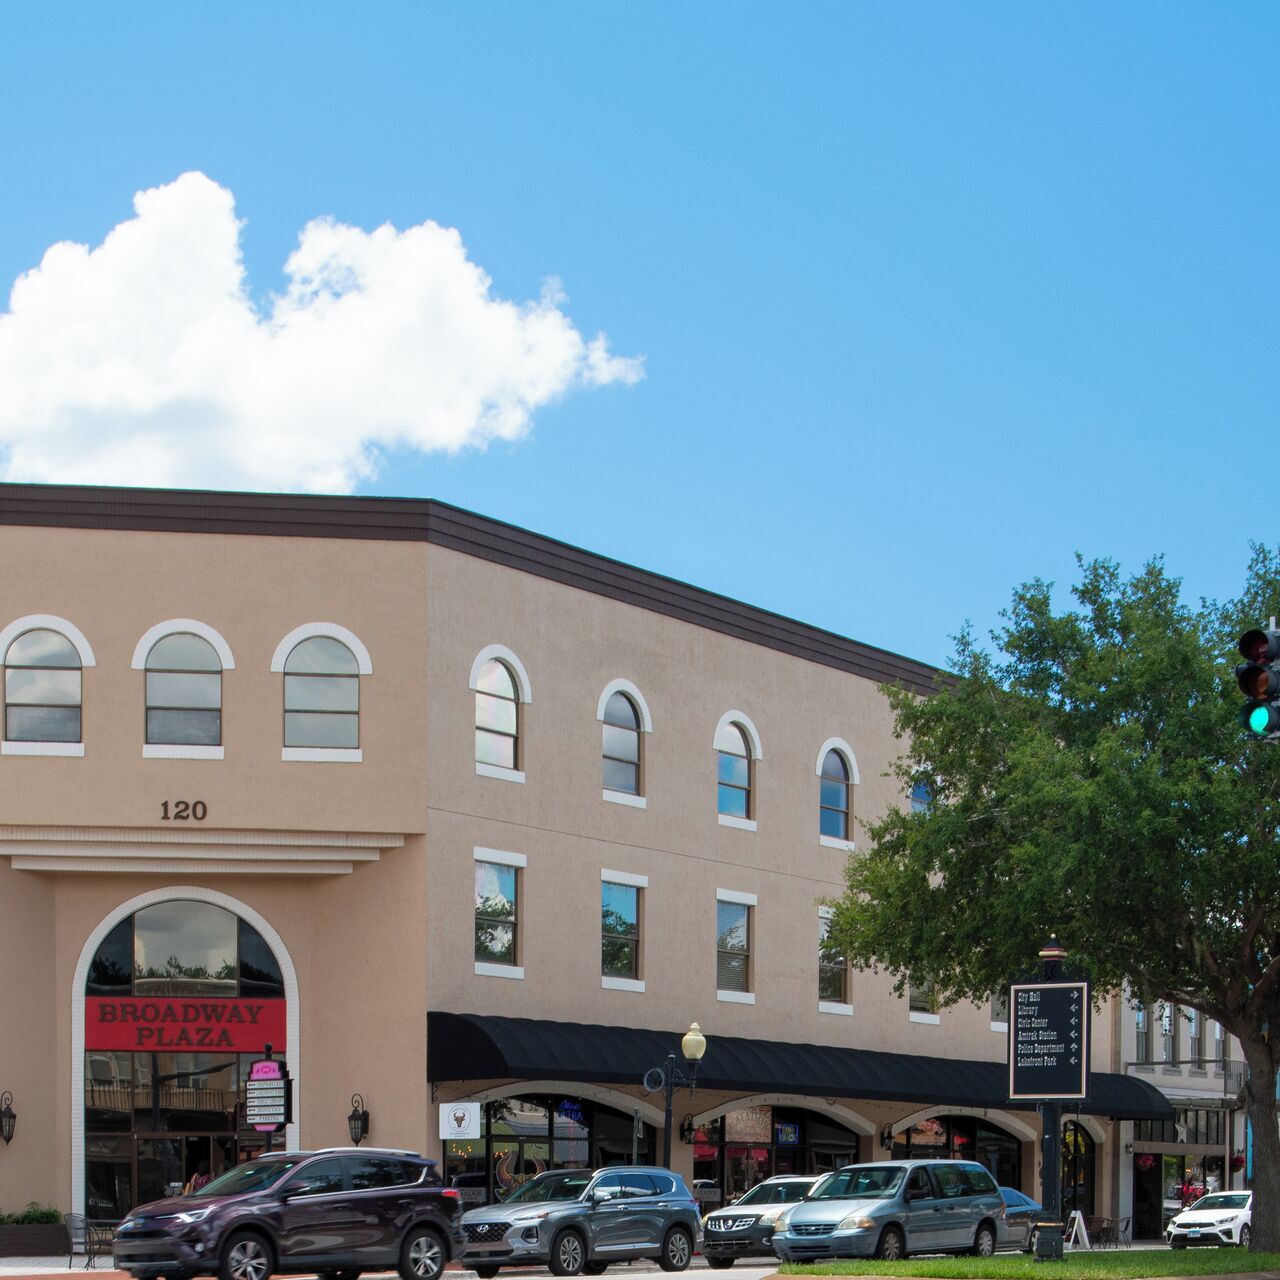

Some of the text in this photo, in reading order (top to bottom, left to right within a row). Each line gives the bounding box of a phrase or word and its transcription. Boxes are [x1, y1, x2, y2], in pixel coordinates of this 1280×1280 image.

[161, 800, 207, 820] 120
[1018, 991, 1040, 1004] City Hall
[98, 1003, 264, 1024] BROADWAY
[1018, 1005, 1038, 1016] Library
[1031, 1018, 1048, 1028] Center
[136, 1026, 234, 1047] PLAZA
[1018, 1030, 1057, 1040] Amtrak Station
[1018, 1043, 1065, 1055] Police Department
[1018, 1056, 1057, 1067] Lakefront Park
